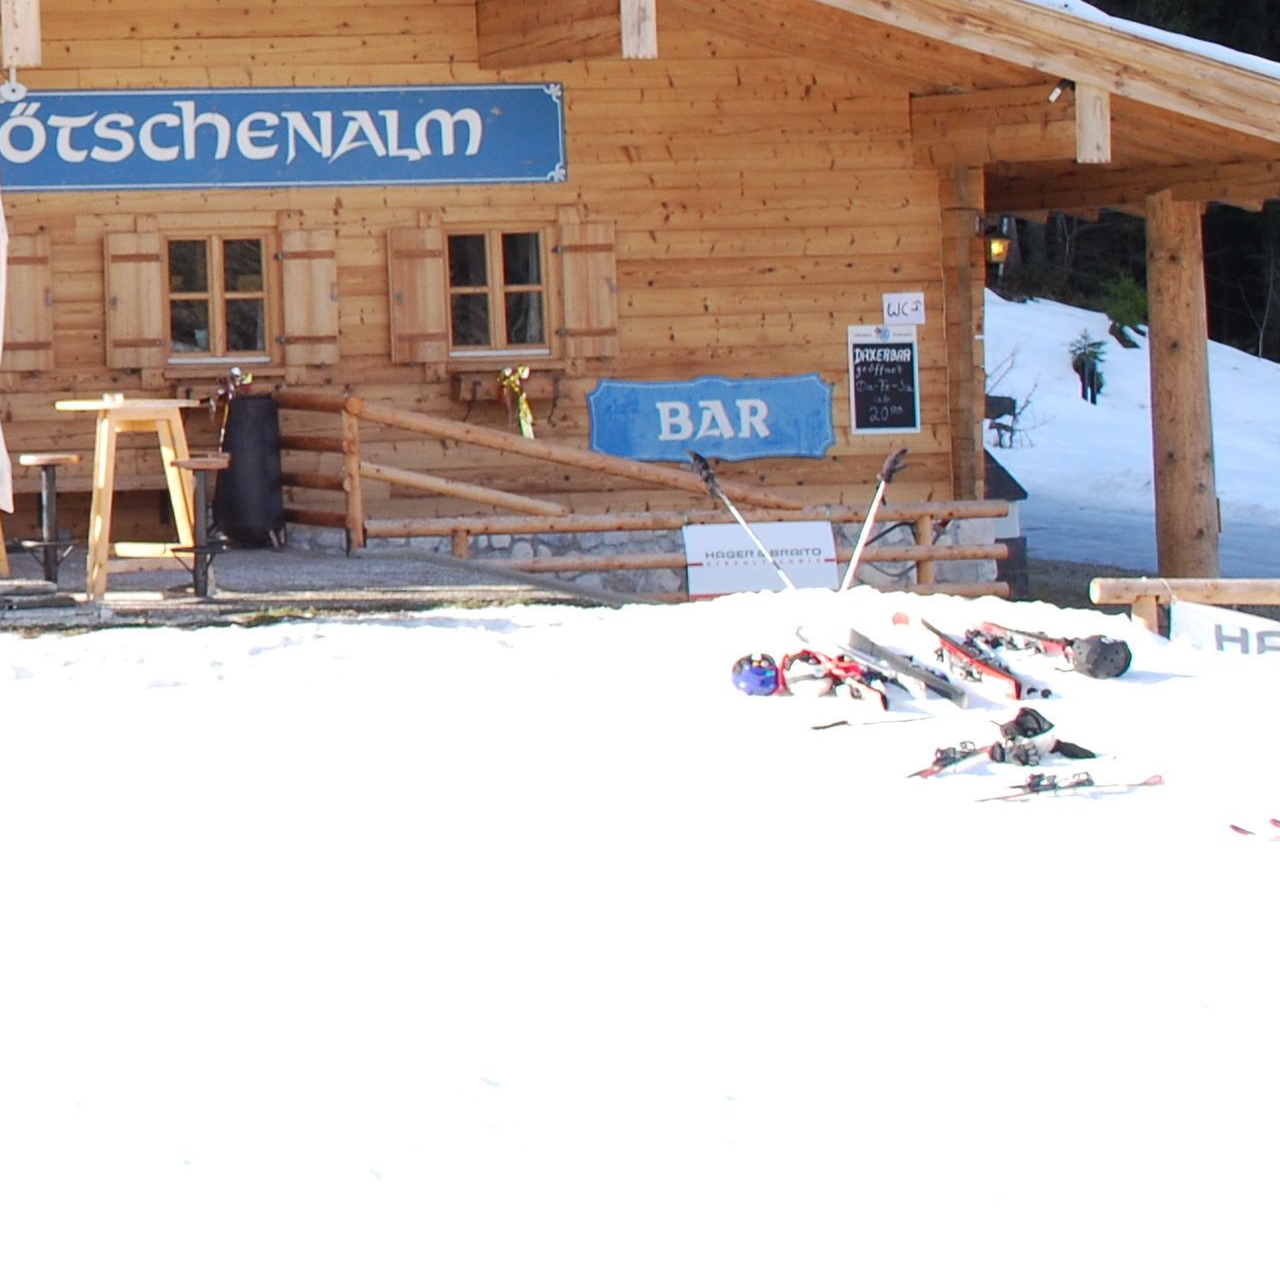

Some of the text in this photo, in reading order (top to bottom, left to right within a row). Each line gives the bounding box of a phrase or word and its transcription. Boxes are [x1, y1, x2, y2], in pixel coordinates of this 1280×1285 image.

[886, 301, 909, 317] WC
[655, 398, 771, 441] BAR
[704, 549, 754, 560] HAGER
[770, 547, 823, 557] BRAITO
